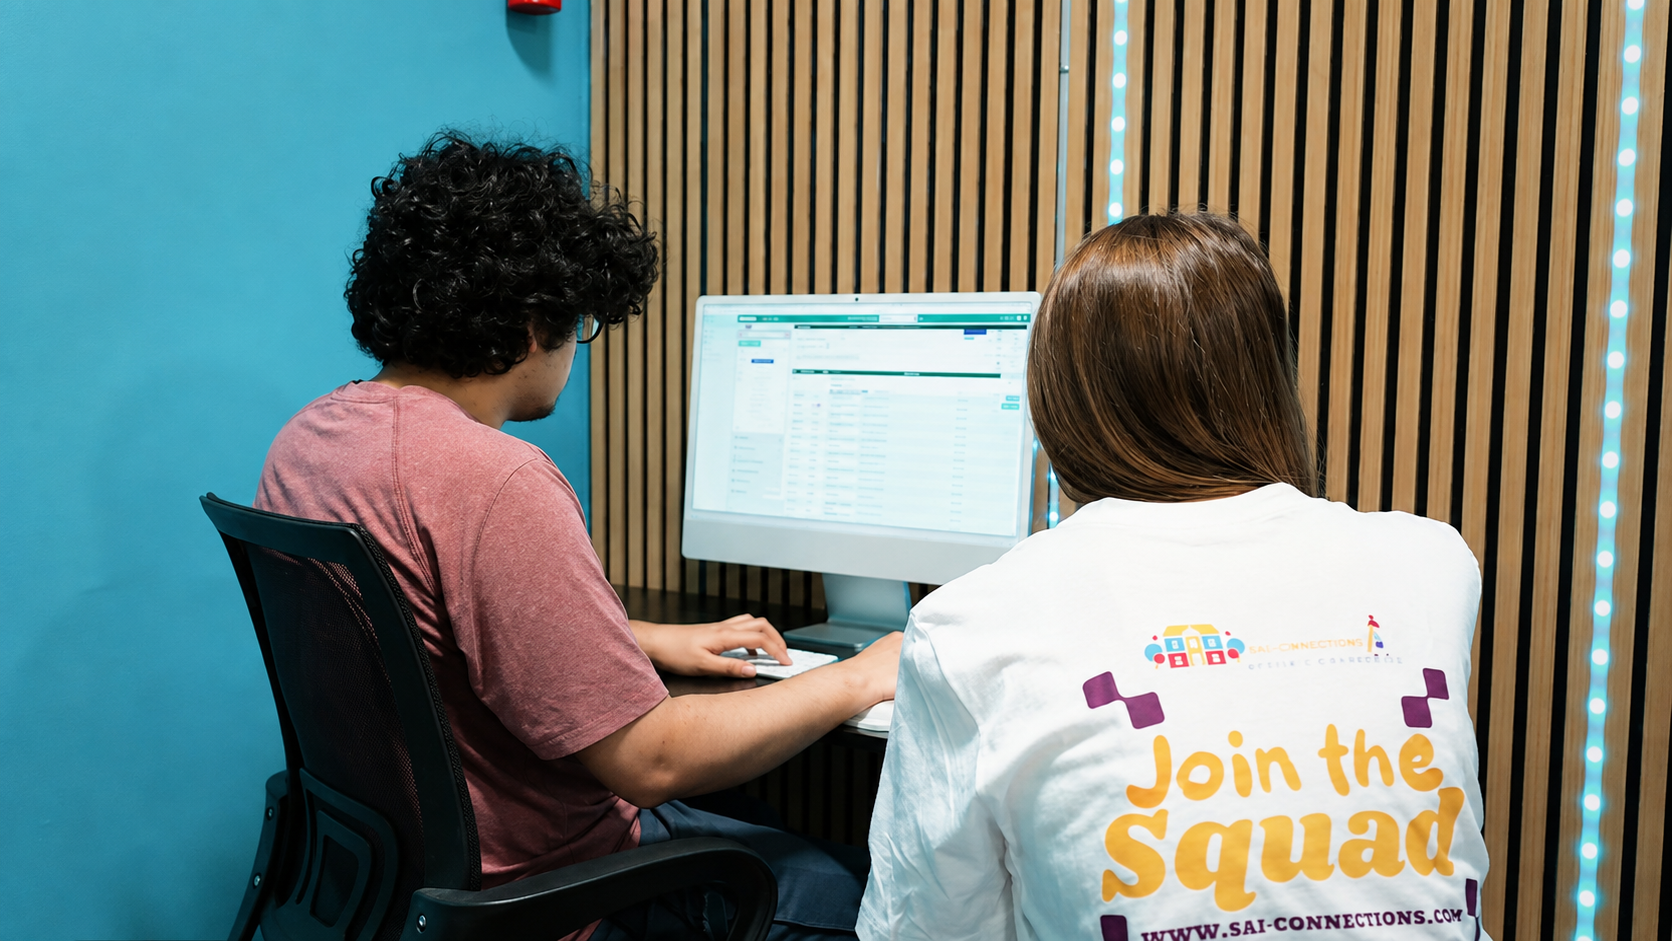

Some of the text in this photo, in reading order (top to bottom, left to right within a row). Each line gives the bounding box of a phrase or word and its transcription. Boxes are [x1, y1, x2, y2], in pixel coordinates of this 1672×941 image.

[1125, 723, 1444, 809] Join the
[1101, 786, 1465, 912] Squad
[1140, 908, 1464, 941] WWW.SAI-CONNECTIONS.COM
